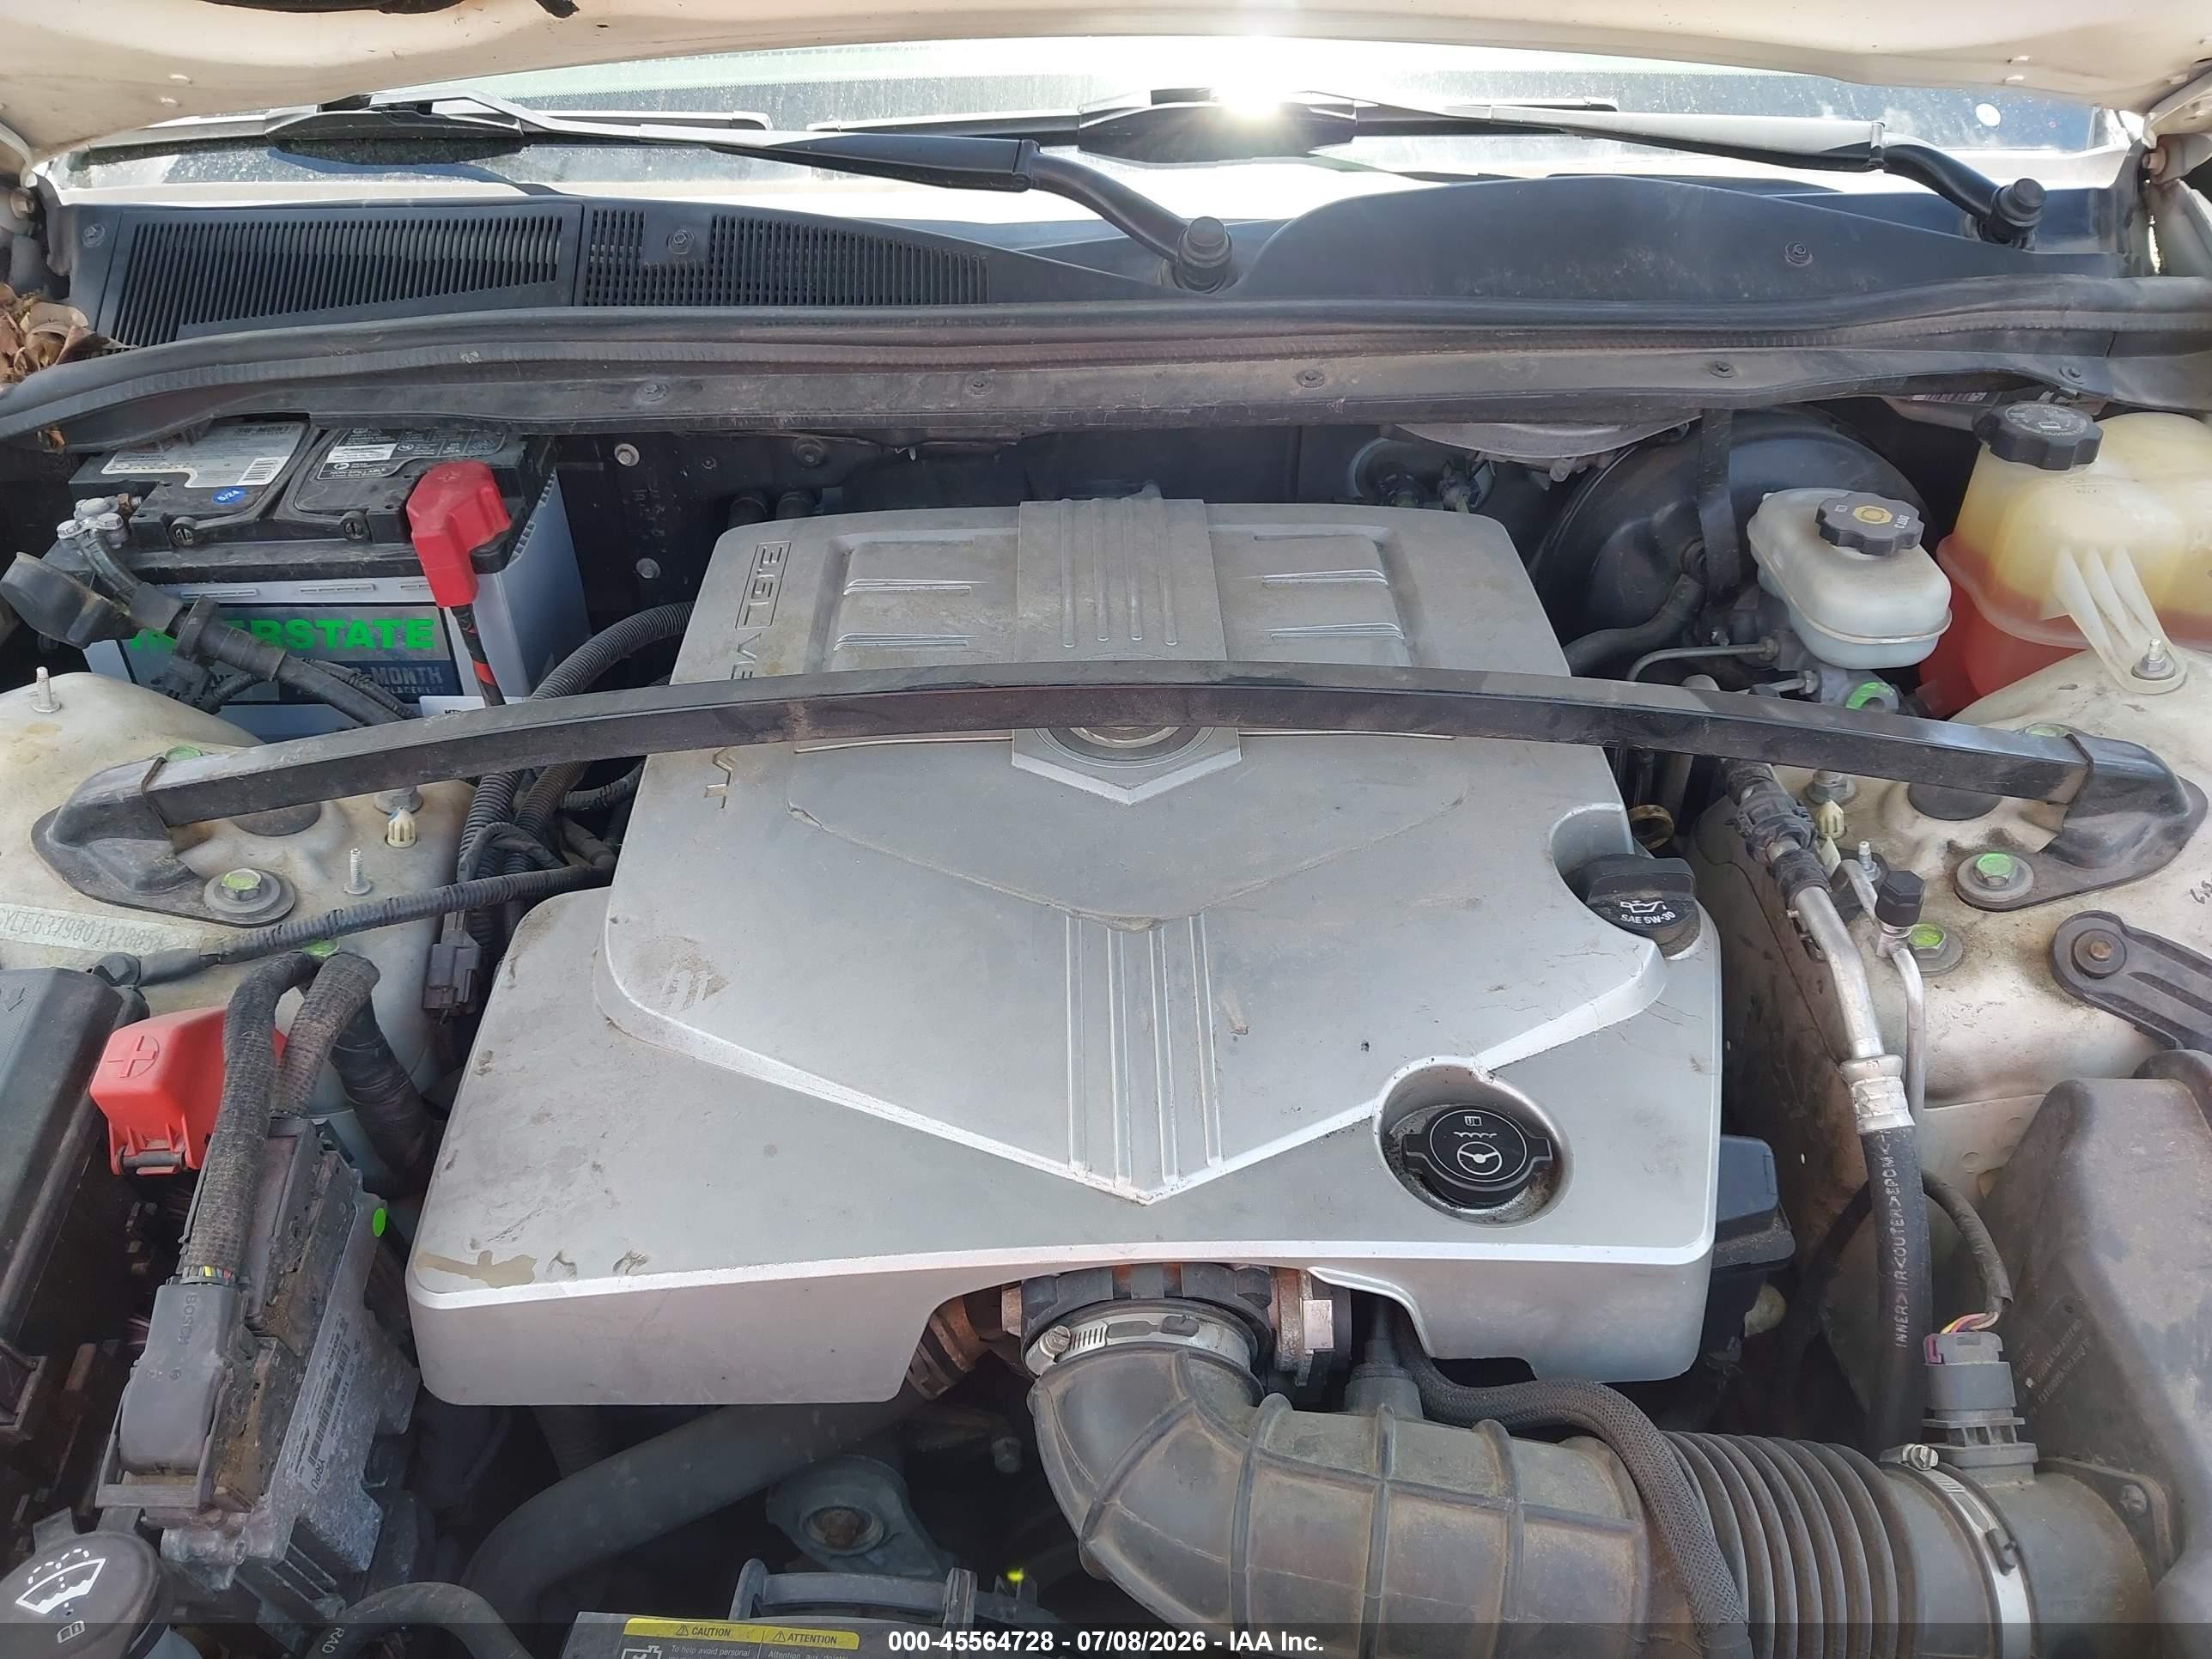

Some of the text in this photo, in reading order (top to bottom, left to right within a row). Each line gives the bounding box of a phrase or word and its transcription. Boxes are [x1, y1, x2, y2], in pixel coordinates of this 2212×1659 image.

[744, 546, 783, 627] 3.6L
[1620, 911, 1676, 924] SAE 5W-30
[179, 1294, 198, 1346] BOSCH
[311, 1458, 325, 1491] YRPU
[322, 1627, 345, 1654] RAD
[691, 1626, 838, 1644] CAUTION ATTENTION
[681, 1645, 696, 1655] help
[698, 1646, 719, 1655] avoid
[719, 1648, 750, 1657] personal
